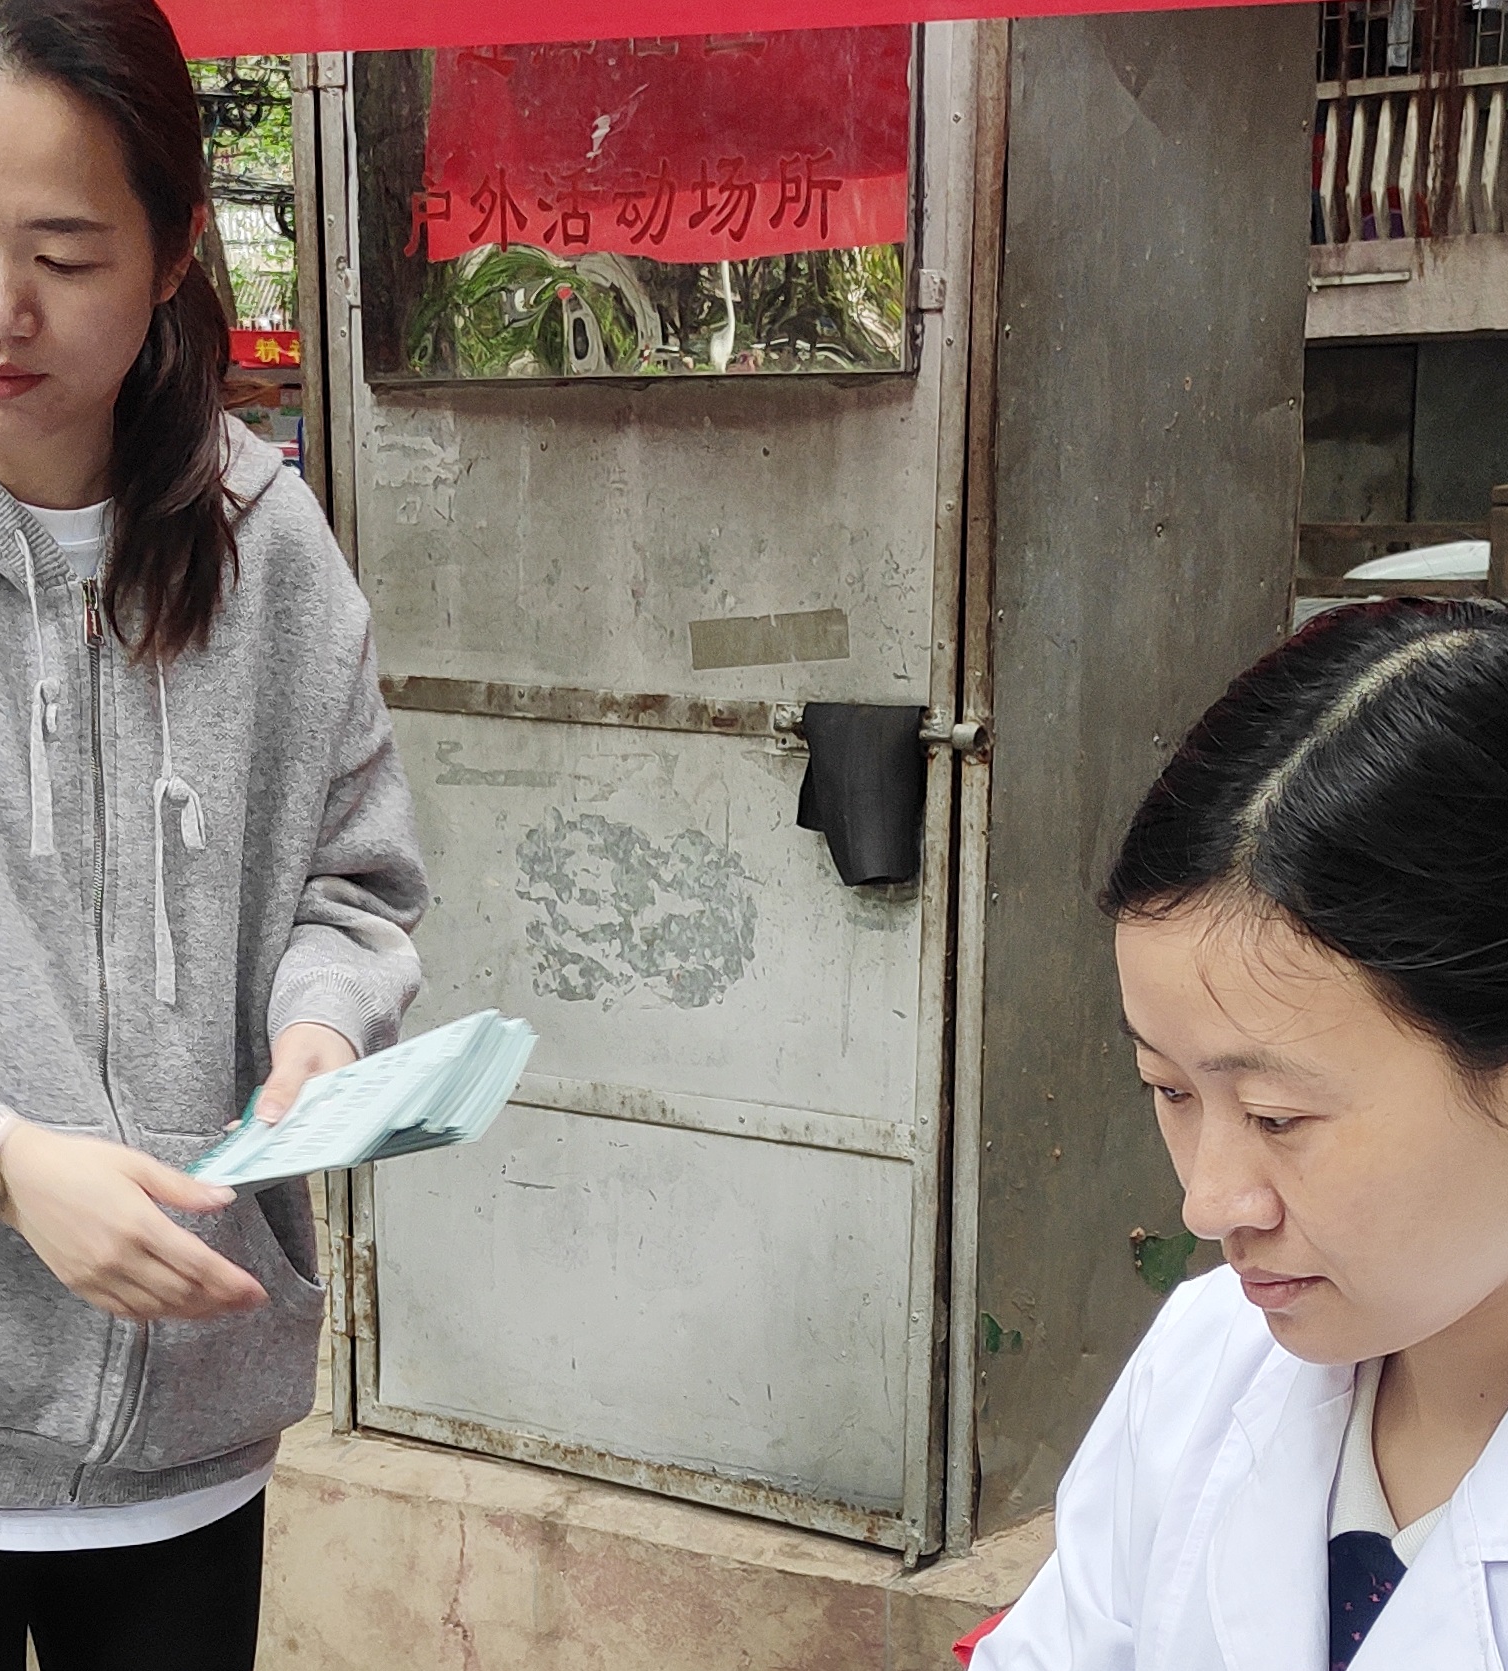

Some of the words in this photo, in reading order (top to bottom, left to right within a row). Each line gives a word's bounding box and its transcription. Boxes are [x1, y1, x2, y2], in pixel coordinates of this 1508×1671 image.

[403, 147, 843, 258] 户外活动场所
